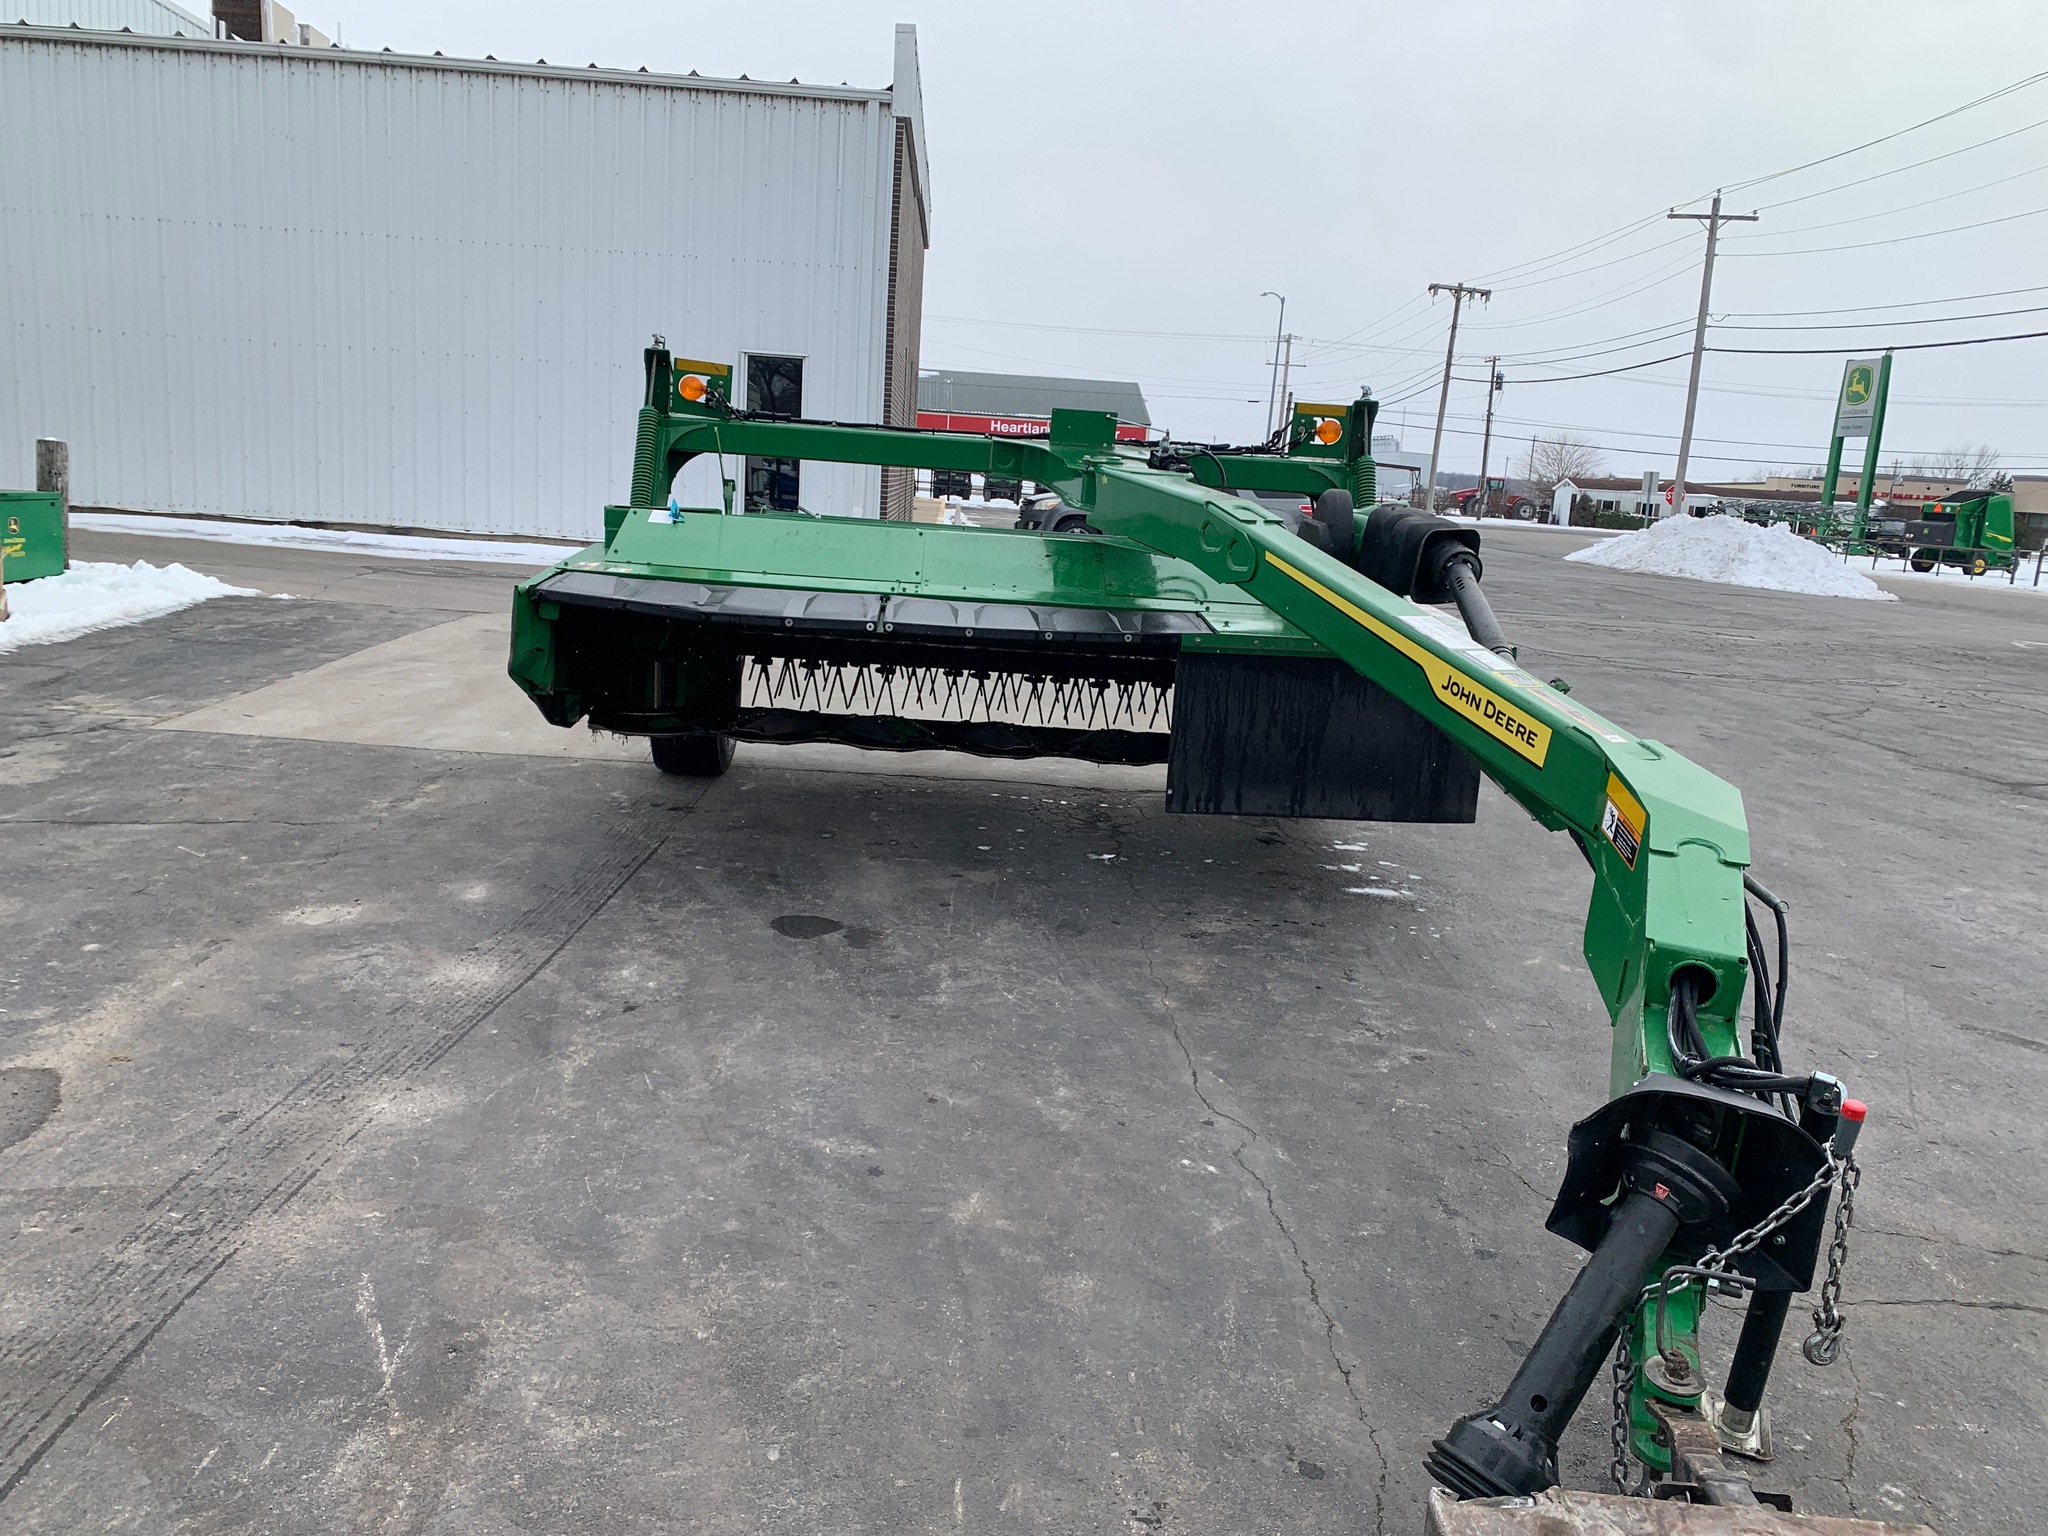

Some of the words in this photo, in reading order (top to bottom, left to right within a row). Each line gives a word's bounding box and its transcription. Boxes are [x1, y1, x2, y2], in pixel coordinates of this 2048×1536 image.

[990, 419, 1050, 434] Heartlan
[1441, 674, 1482, 712] JOHN
[1483, 698, 1538, 749] DEERE
